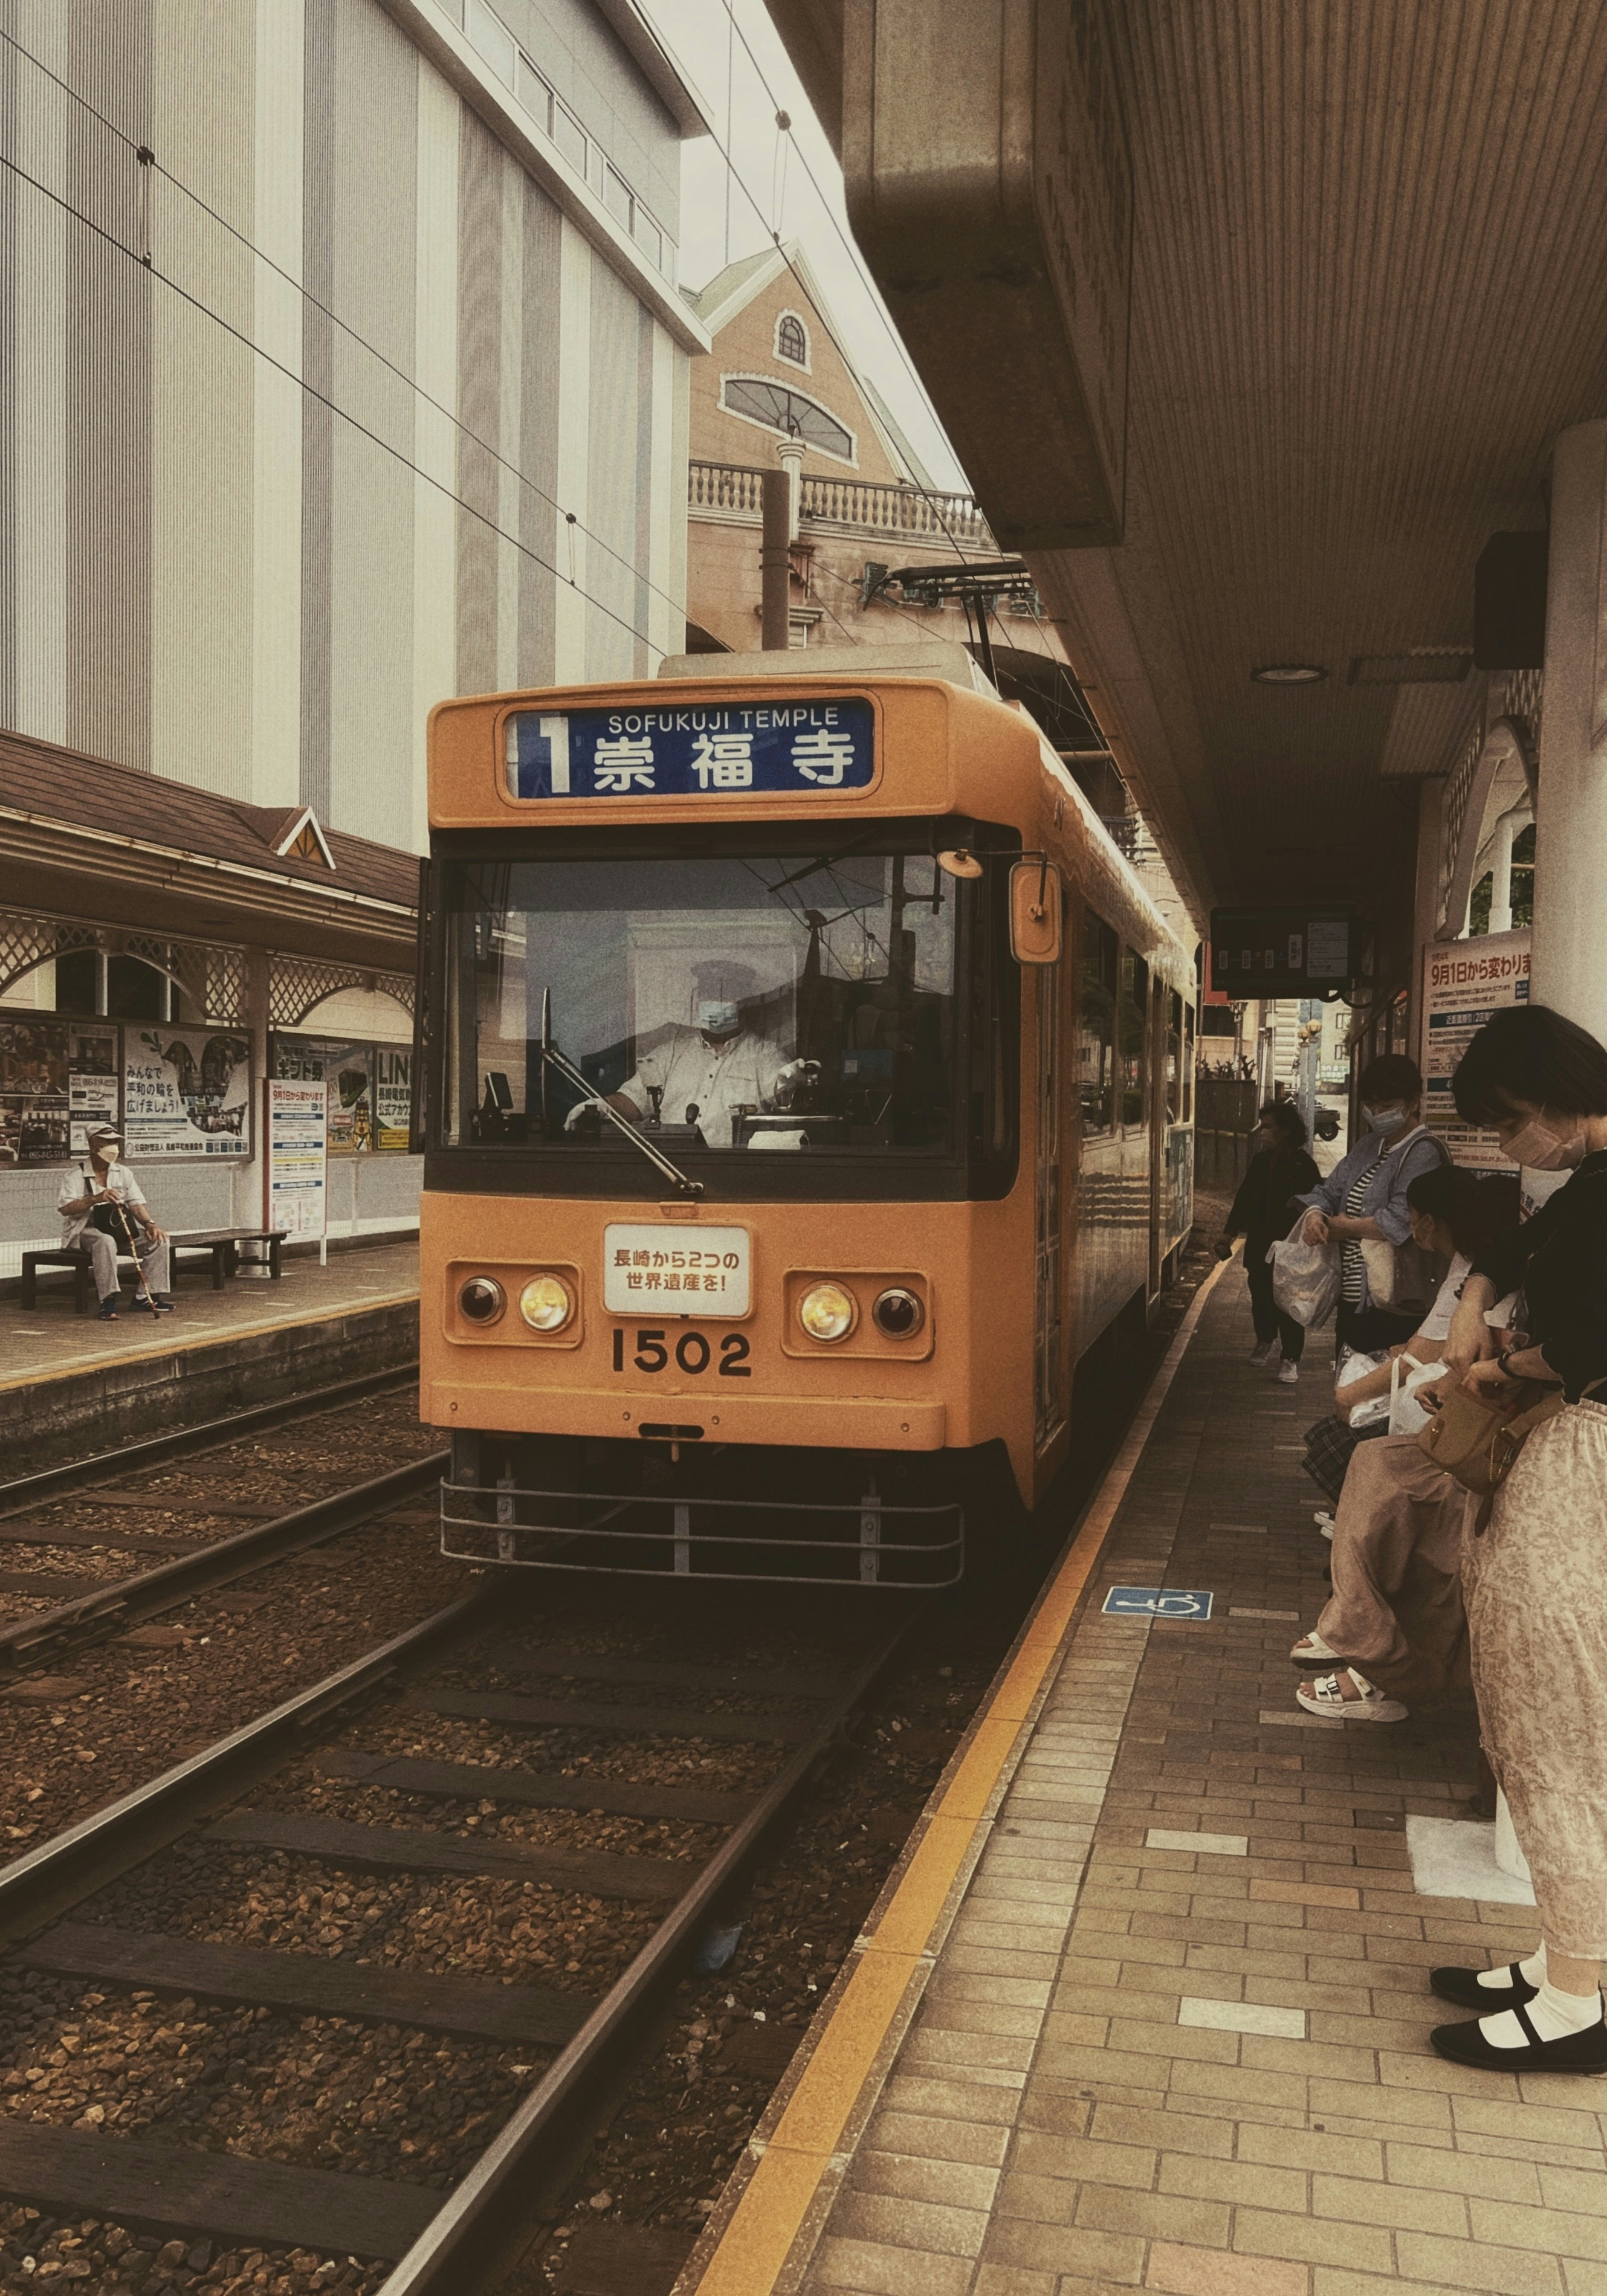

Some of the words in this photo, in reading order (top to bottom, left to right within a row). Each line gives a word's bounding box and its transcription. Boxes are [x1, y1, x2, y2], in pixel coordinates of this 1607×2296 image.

[609, 711, 729, 734] SOFUKUJI
[739, 707, 839, 729] TEMPLE
[540, 717, 571, 793] 1
[593, 729, 856, 792] 崇福寺
[126, 1065, 162, 1080] みんなで
[378, 1053, 412, 1085] LIN
[126, 1082, 174, 1097] 平和の輪を
[614, 1249, 740, 1269] 長崎から2つの
[627, 1272, 726, 1292] 世界遺産を!
[613, 1328, 752, 1377] 1502
